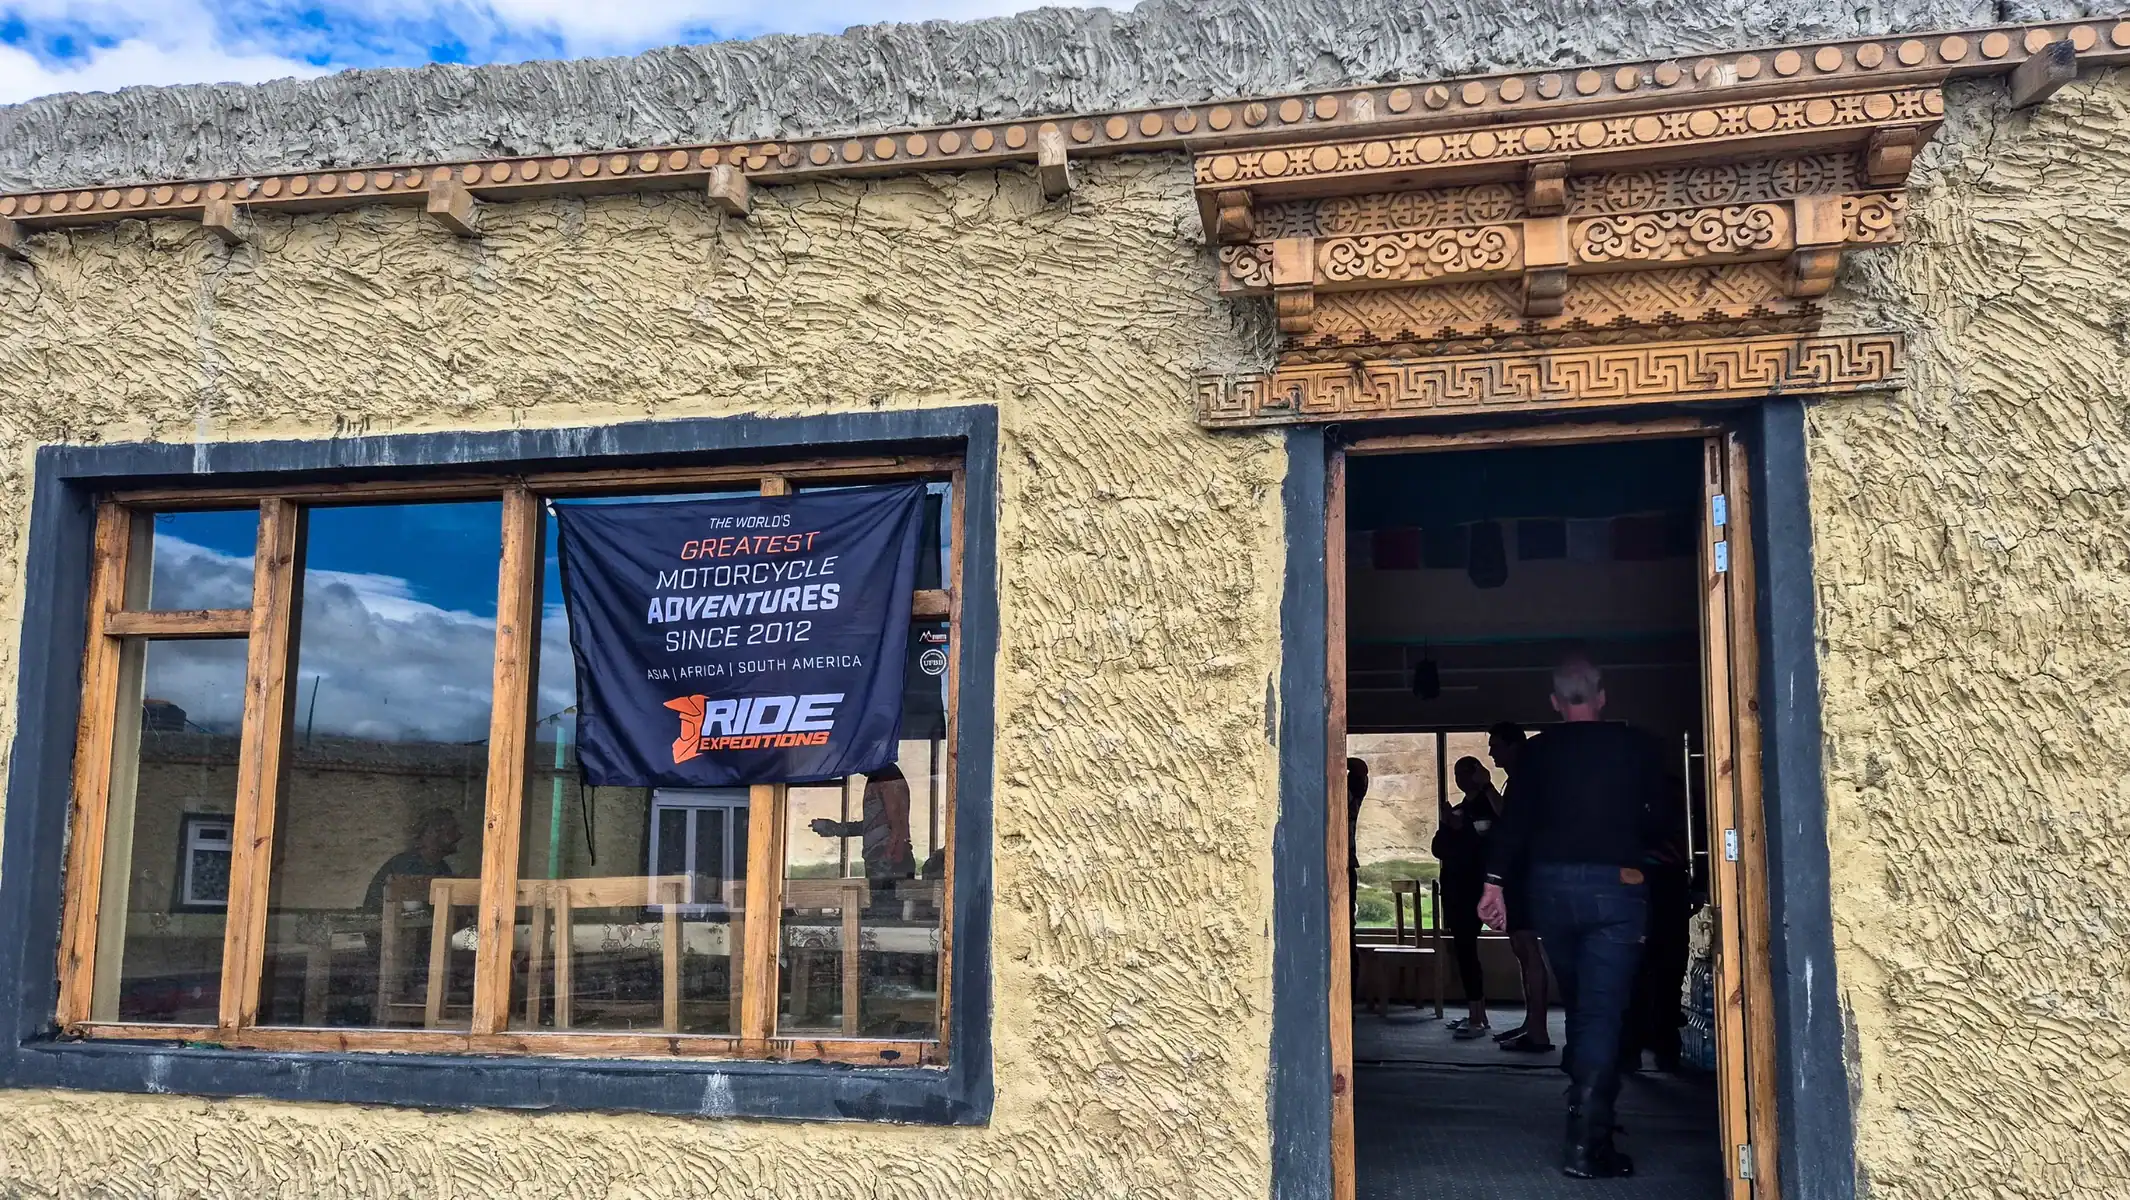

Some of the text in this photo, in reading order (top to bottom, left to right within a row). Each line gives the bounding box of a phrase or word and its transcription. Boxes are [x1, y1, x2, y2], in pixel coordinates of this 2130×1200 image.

[710, 514, 791, 528] THE WORLD'S
[681, 531, 821, 560] GREATEST
[656, 556, 839, 590] MOTORCYCLE
[648, 583, 841, 624] ADVENTURES
[666, 621, 812, 652] SINCE 2012
[647, 667, 670, 680] ASIA
[680, 664, 725, 679] AFRICA
[738, 659, 786, 673] SOUTH
[792, 655, 862, 670] AMERICA
[701, 692, 845, 736] RIDE
[700, 731, 832, 751] EXPEDITIONS
